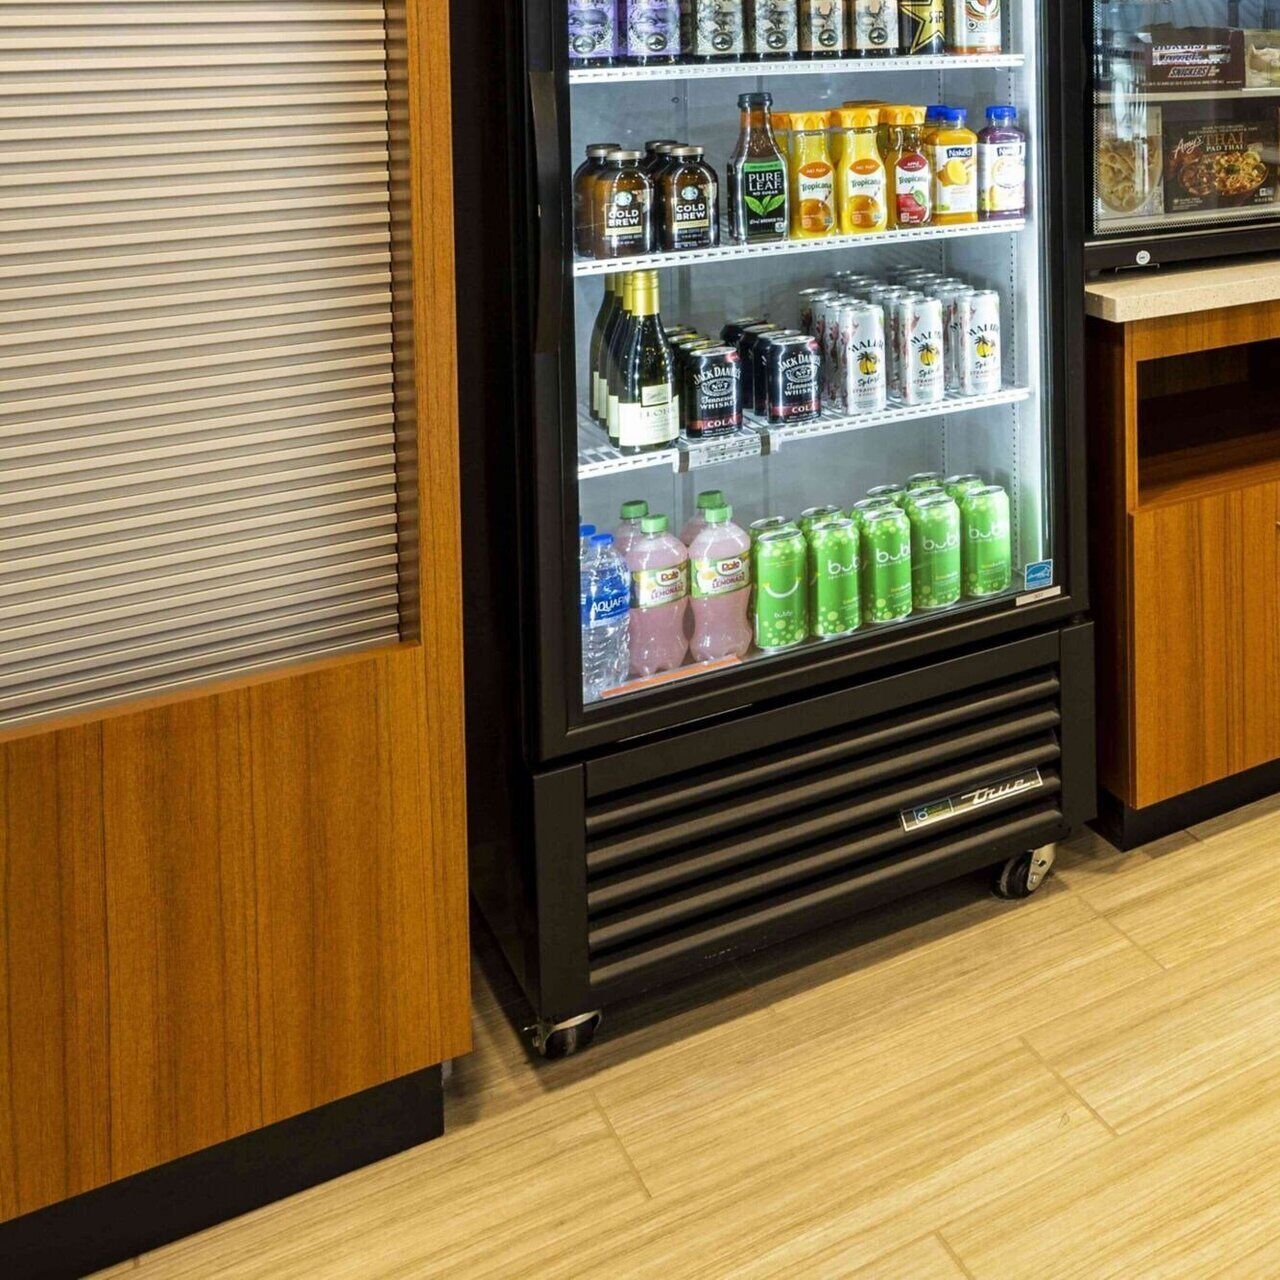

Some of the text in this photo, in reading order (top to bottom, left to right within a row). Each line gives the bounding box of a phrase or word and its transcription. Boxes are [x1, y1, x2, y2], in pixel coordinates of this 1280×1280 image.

[1203, 133, 1244, 145] THAI
[749, 172, 781, 182] PURE
[802, 183, 832, 192] Tropicana
[676, 204, 705, 213] COLD
[609, 210, 639, 218] COLD
[676, 211, 705, 221] BREW
[609, 218, 639, 227] BREW
[693, 370, 713, 385] JACK
[700, 401, 737, 410] WHISKE
[721, 561, 741, 572] Dole
